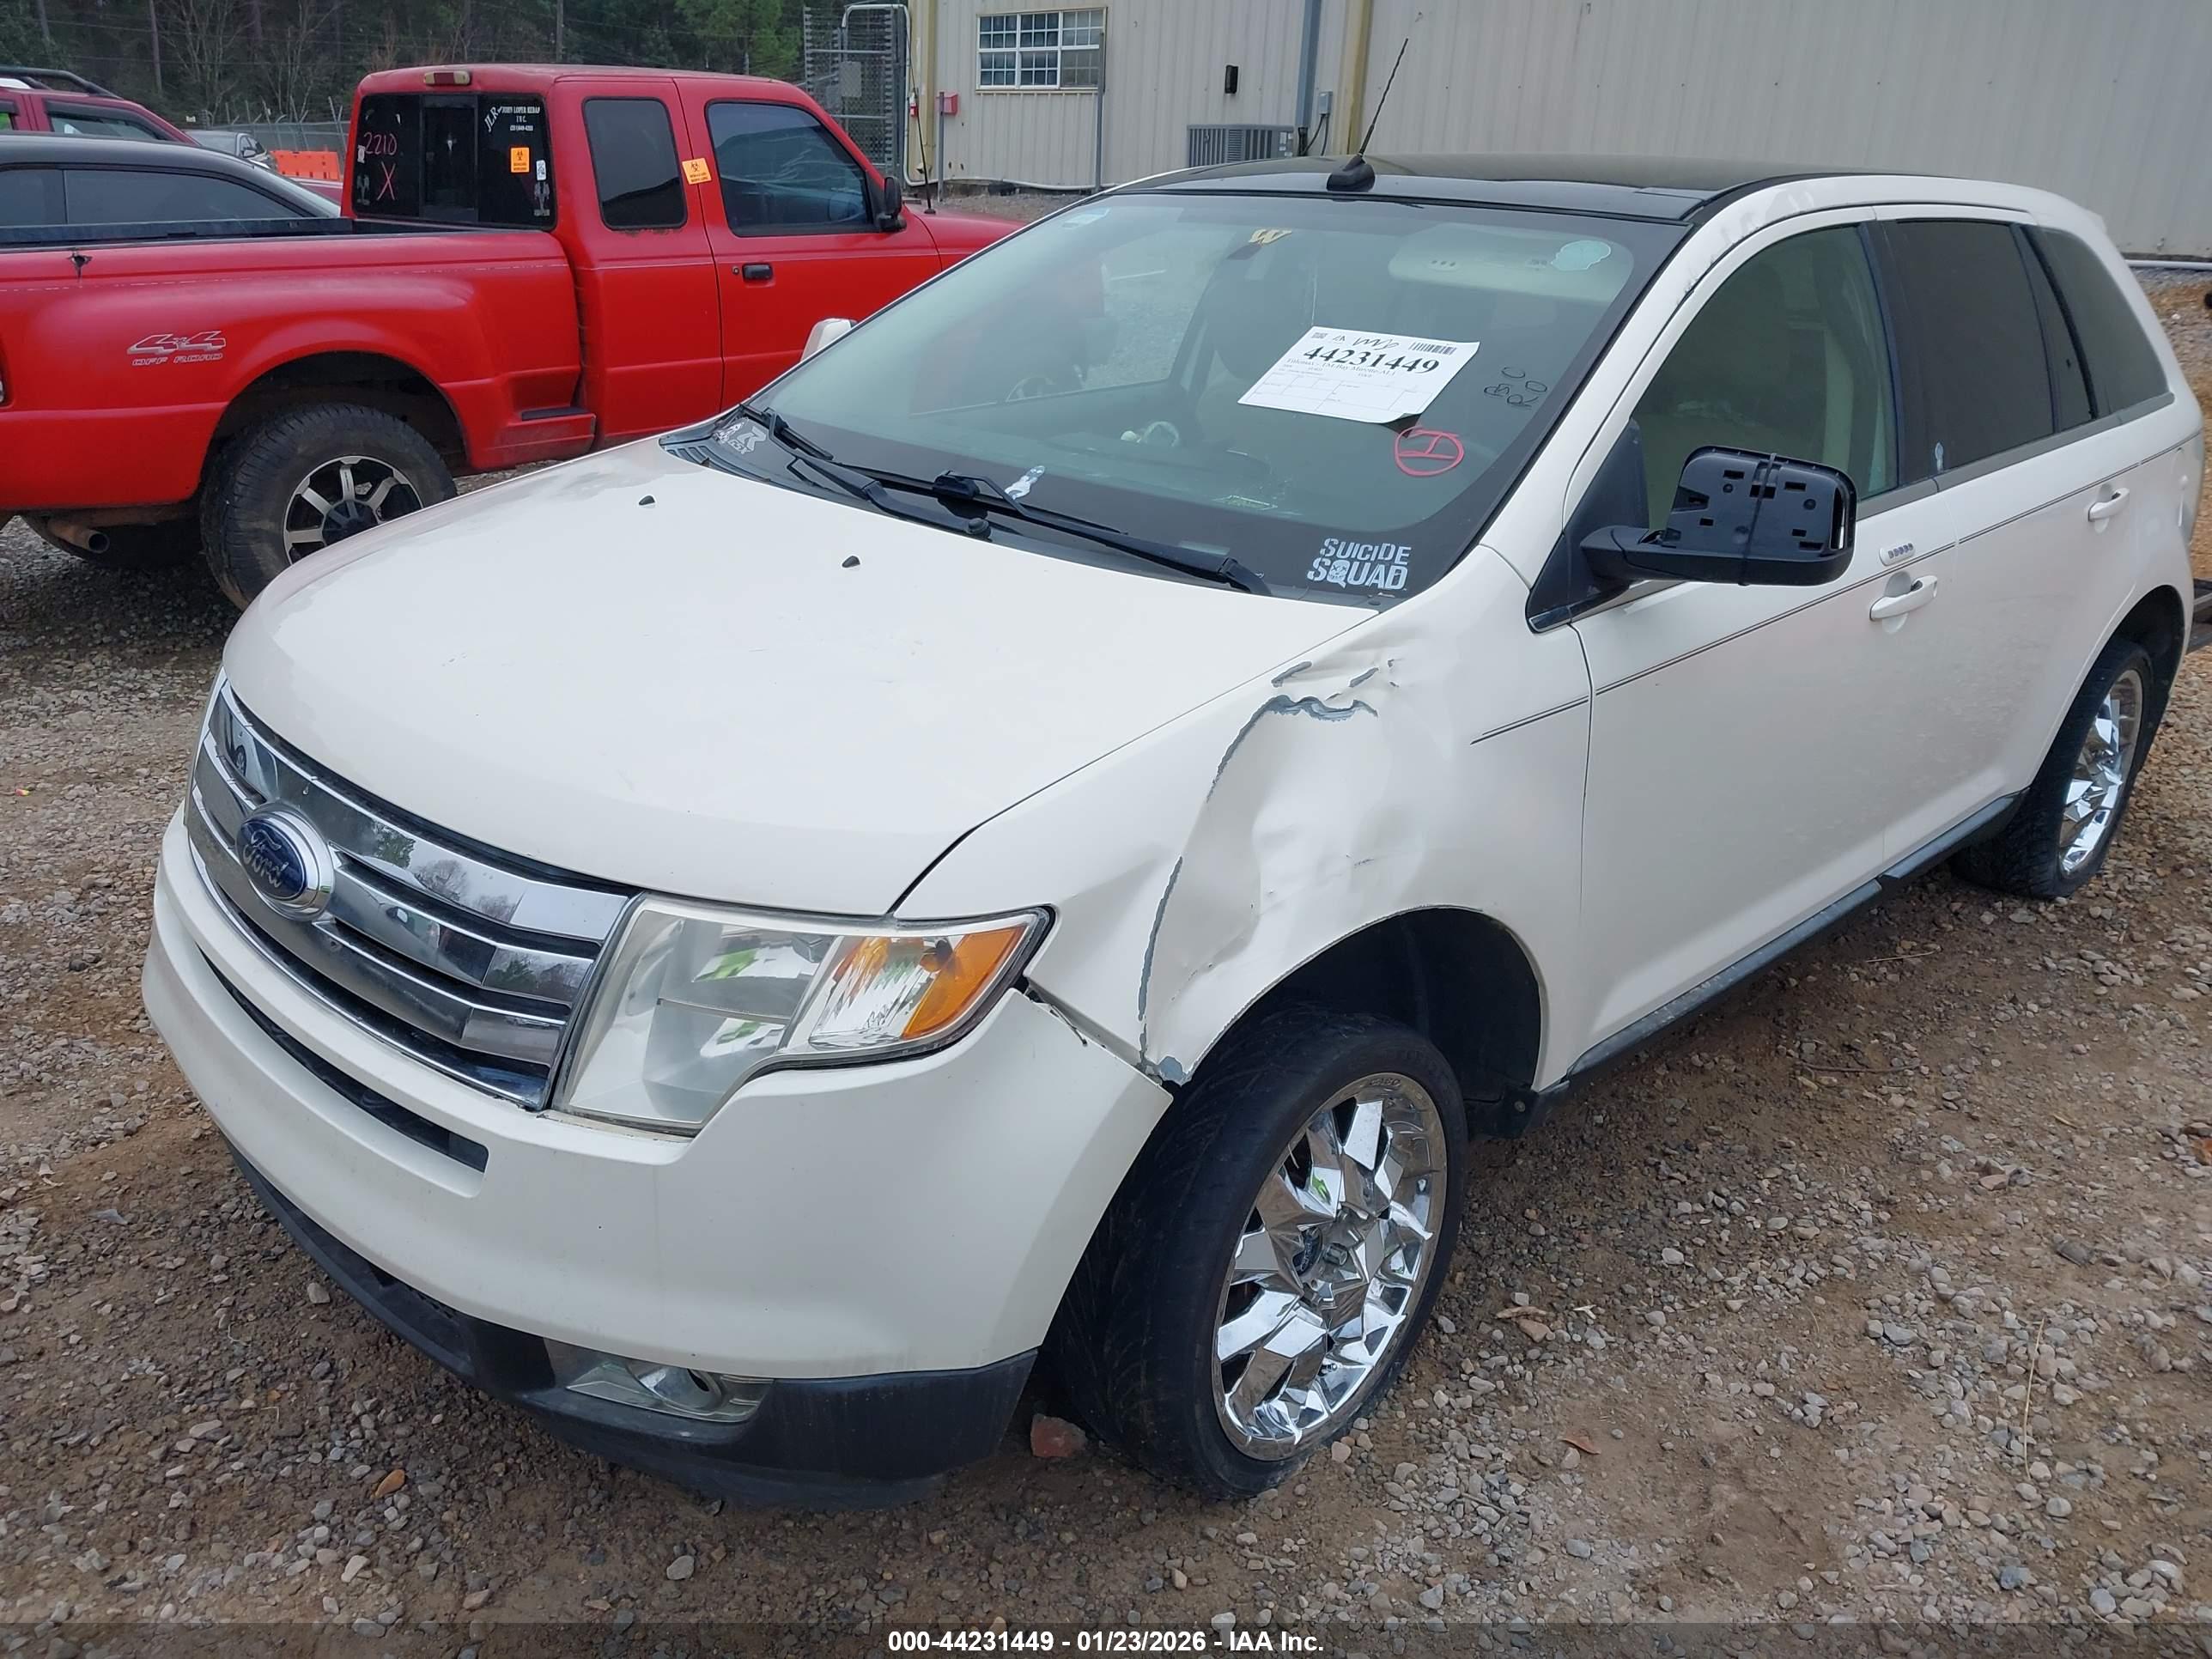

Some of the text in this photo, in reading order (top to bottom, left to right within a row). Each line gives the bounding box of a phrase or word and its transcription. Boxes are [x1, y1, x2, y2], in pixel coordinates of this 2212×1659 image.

[1304, 345, 1441, 374] 44231449
[1320, 538, 1412, 565] SUICIDE
[1307, 557, 1408, 590] SQUAD
